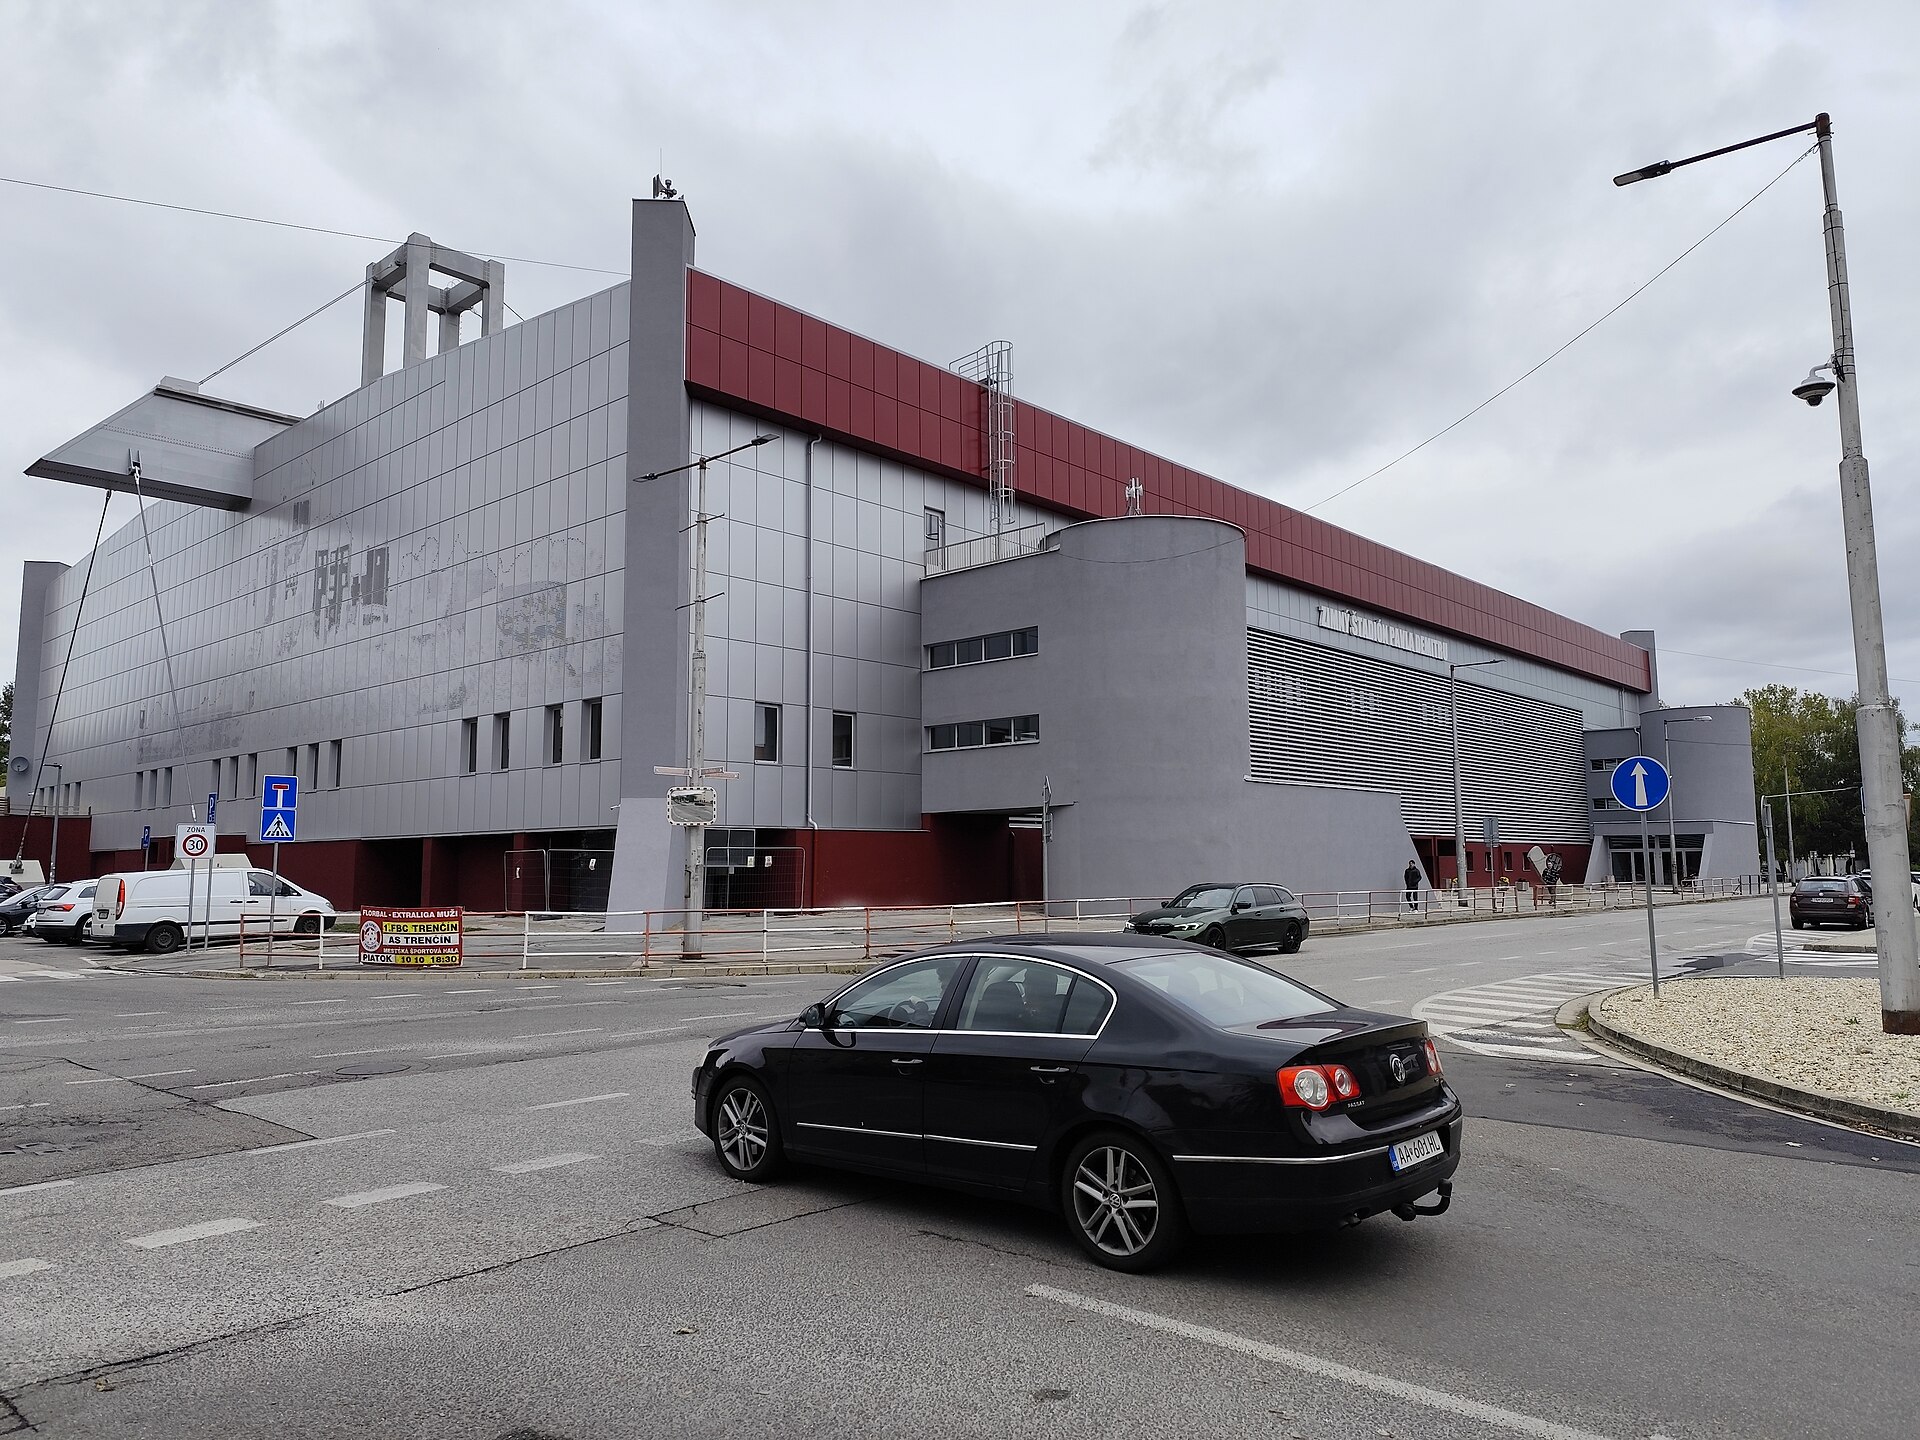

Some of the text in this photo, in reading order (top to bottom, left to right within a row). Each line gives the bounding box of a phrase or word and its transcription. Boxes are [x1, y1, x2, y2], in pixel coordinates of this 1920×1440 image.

[188, 839, 203, 851] 30
[362, 909, 388, 918] FLORBAL
[392, 911, 435, 919] EXTRALIGA
[436, 910, 458, 918] MUŽI
[383, 924, 409, 933] 1.FBC
[411, 922, 458, 933] TRENČÍN
[388, 933, 451, 944] AS TRENČÍN
[363, 954, 393, 963] PIATOK
[430, 955, 457, 963] 18:30
